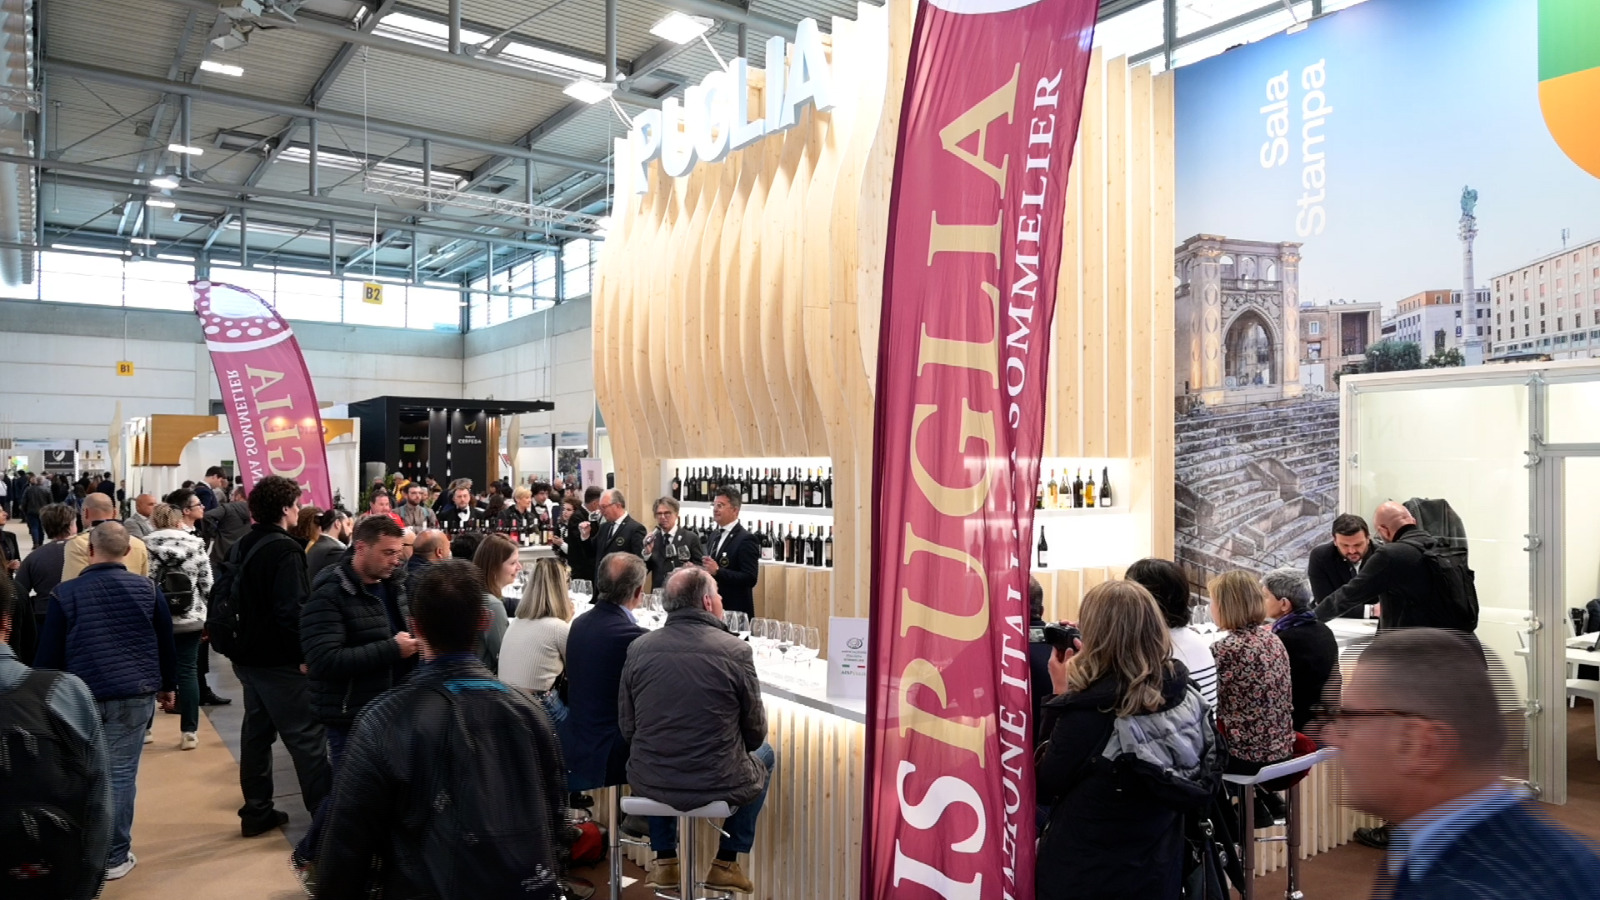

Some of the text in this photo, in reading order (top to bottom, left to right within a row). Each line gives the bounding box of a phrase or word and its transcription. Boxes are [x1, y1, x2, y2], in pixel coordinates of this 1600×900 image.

[631, 17, 835, 195] PUGLIA
[1260, 70, 1289, 169] Sala
[1296, 58, 1333, 237] Stampa
[366, 287, 381, 301] B2
[120, 364, 130, 373] B1
